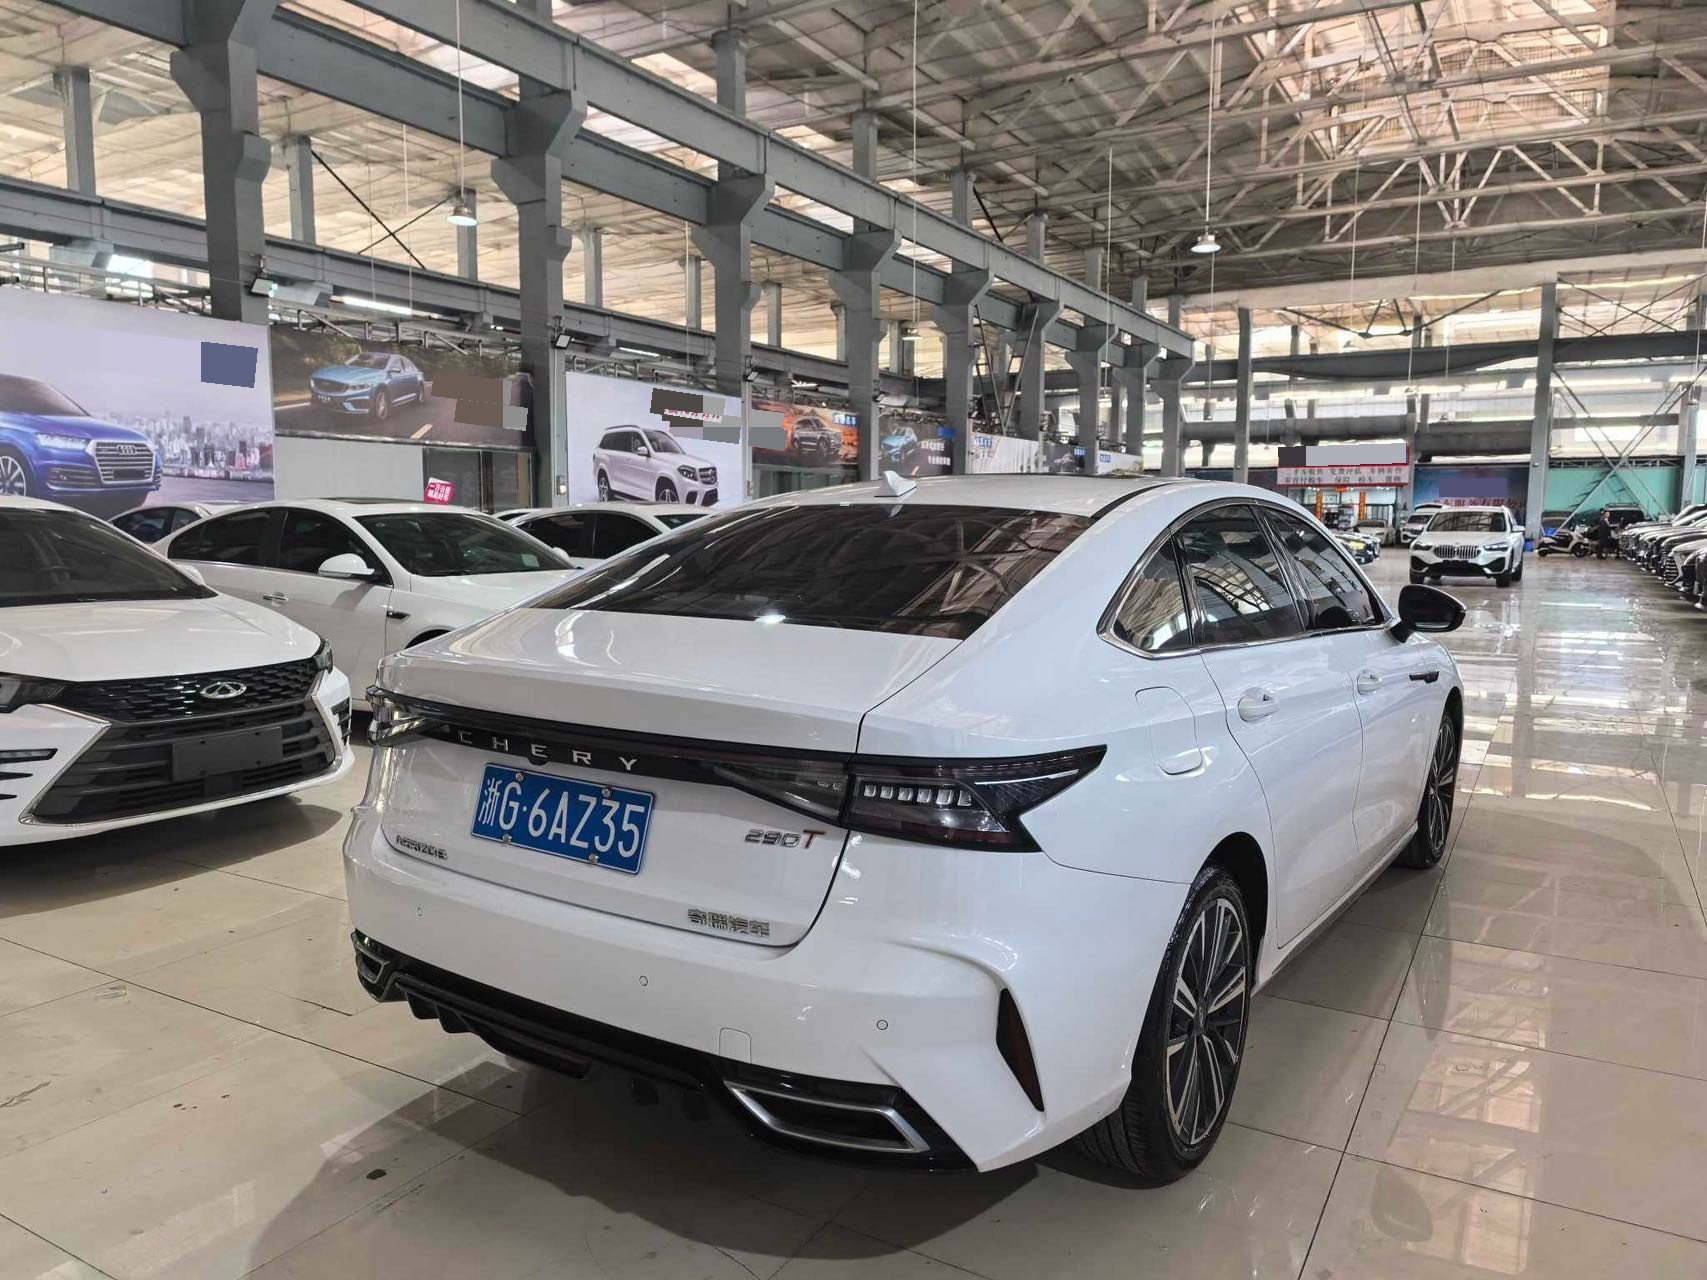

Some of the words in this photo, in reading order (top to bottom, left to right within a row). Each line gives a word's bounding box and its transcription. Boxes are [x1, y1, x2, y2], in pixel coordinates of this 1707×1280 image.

[458, 730, 638, 771] CHERY
[744, 828, 826, 849] 290T
[687, 908, 770, 937] 奇瑞汽车
